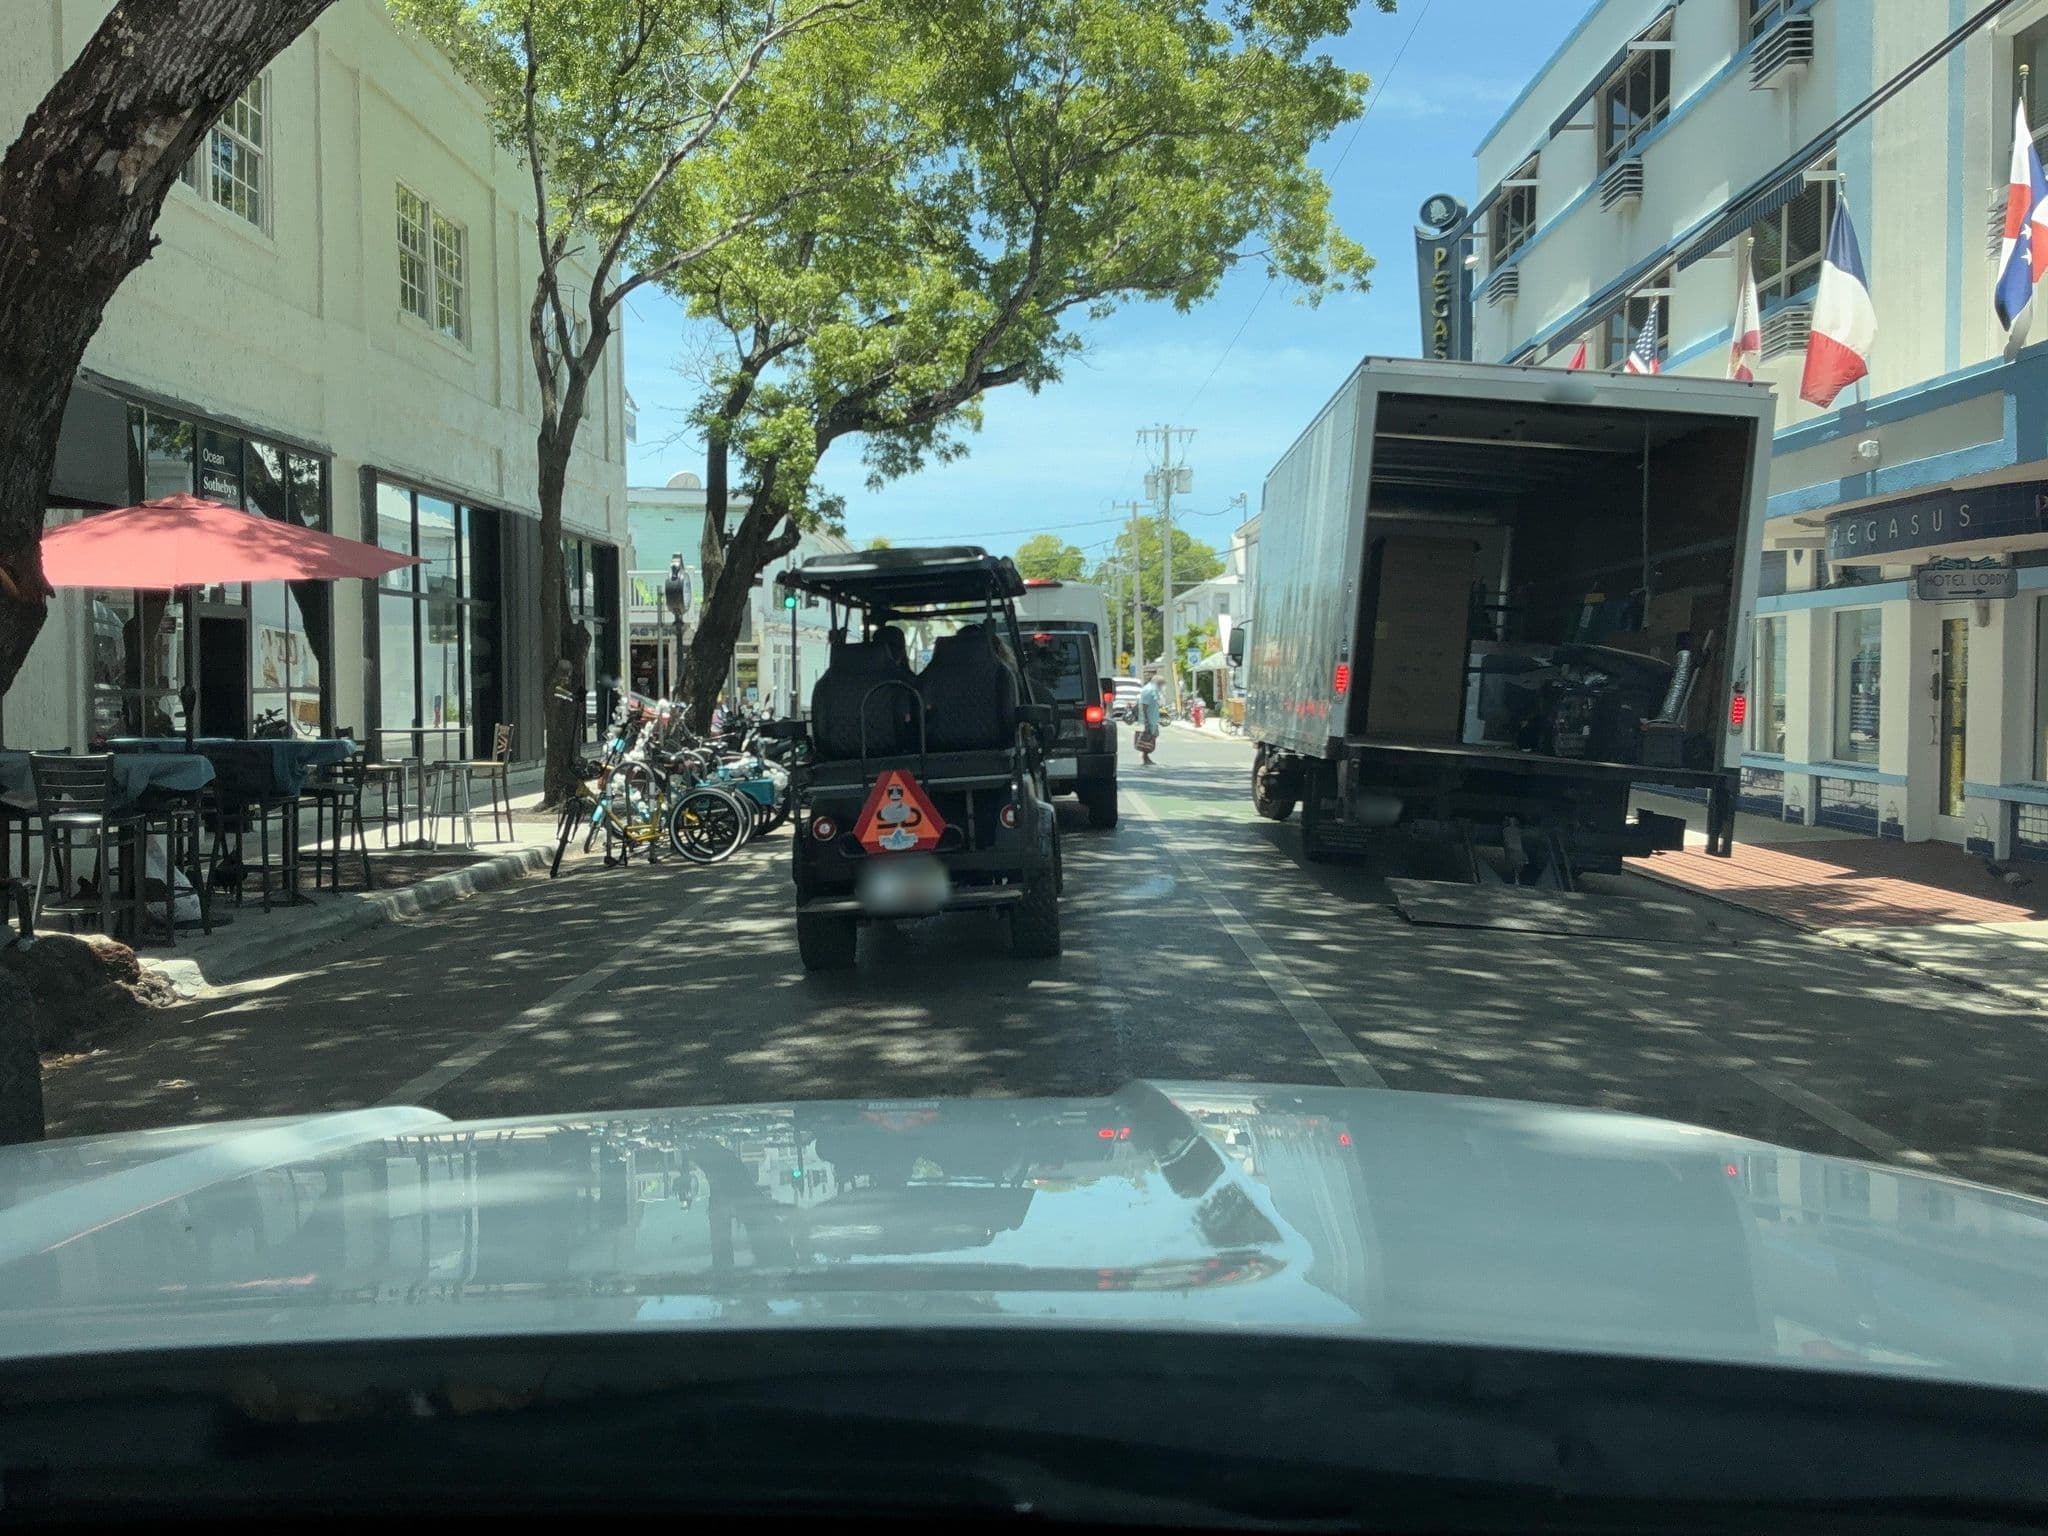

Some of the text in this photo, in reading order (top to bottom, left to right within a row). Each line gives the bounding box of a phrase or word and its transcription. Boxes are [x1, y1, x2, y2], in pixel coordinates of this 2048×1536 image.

[202, 447, 225, 466] Ocean
[203, 476, 237, 498] Sotheby's
[1831, 503, 1971, 546] PEGASUS
[1927, 573, 2009, 587] HOTEL LOBBY
